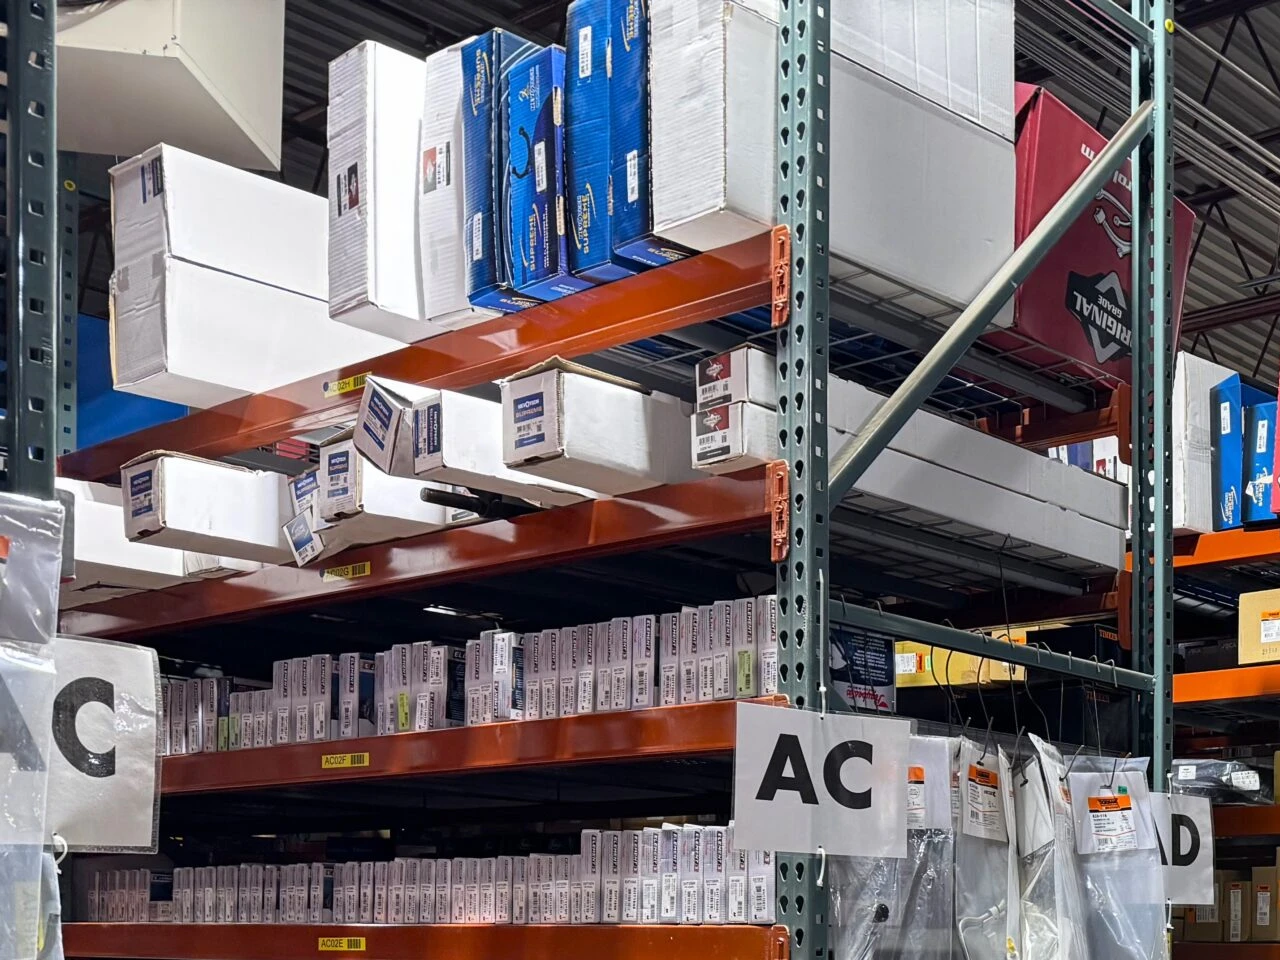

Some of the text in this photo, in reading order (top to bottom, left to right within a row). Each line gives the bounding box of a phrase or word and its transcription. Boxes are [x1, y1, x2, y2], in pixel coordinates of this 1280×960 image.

[1098, 295, 1122, 318] GRADE
[1073, 291, 1132, 347] RIGINAL
[324, 755, 347, 765] AC02F
[755, 734, 874, 810] AC
[321, 939, 344, 948] AC02E
